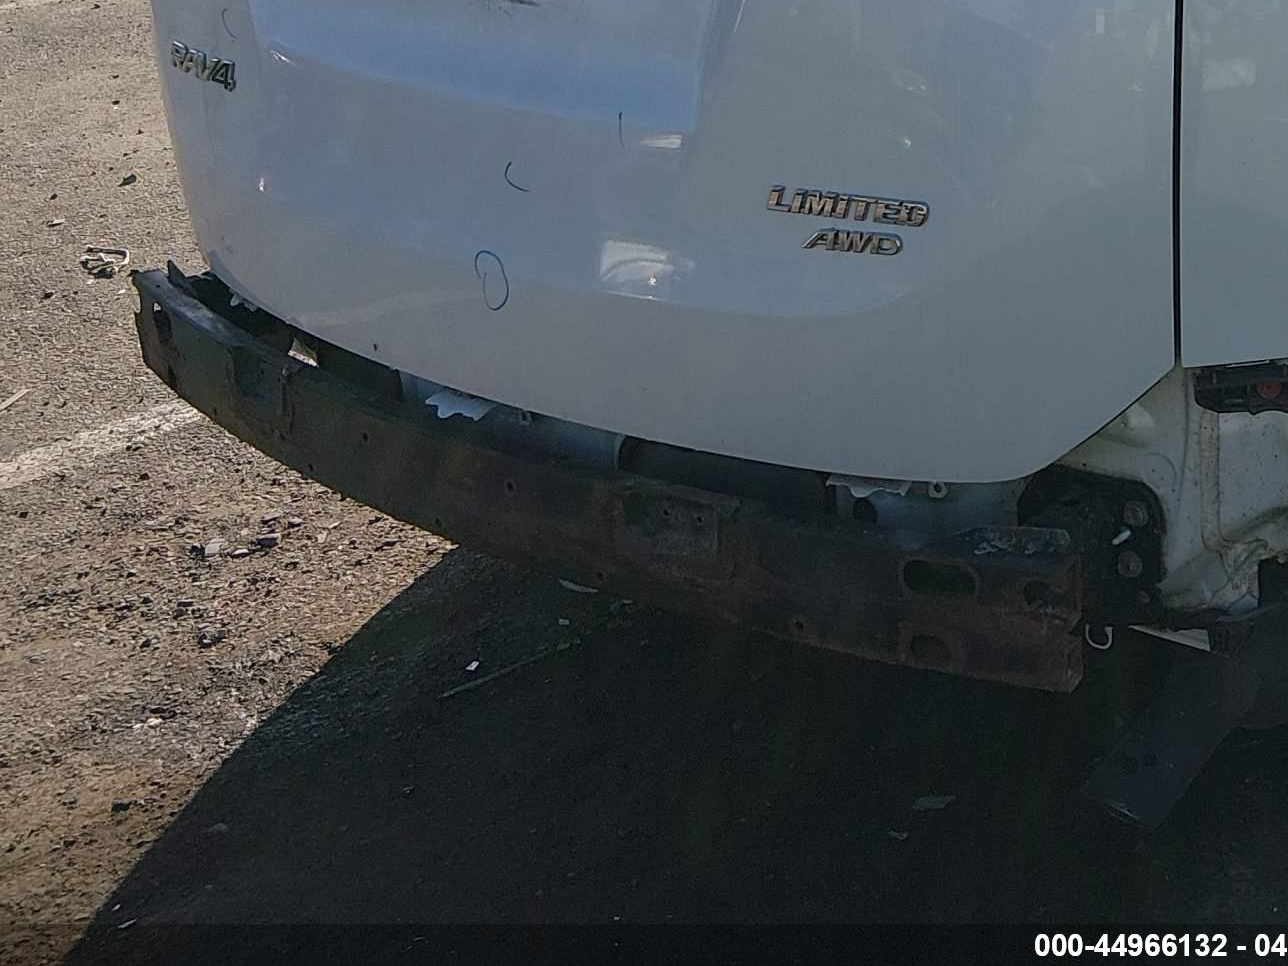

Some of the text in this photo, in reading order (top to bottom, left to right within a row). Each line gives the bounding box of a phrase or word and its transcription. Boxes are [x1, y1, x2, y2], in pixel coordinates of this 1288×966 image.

[171, 40, 236, 92] RAV4
[767, 184, 930, 227] LIMITED
[801, 228, 904, 256] AWD
